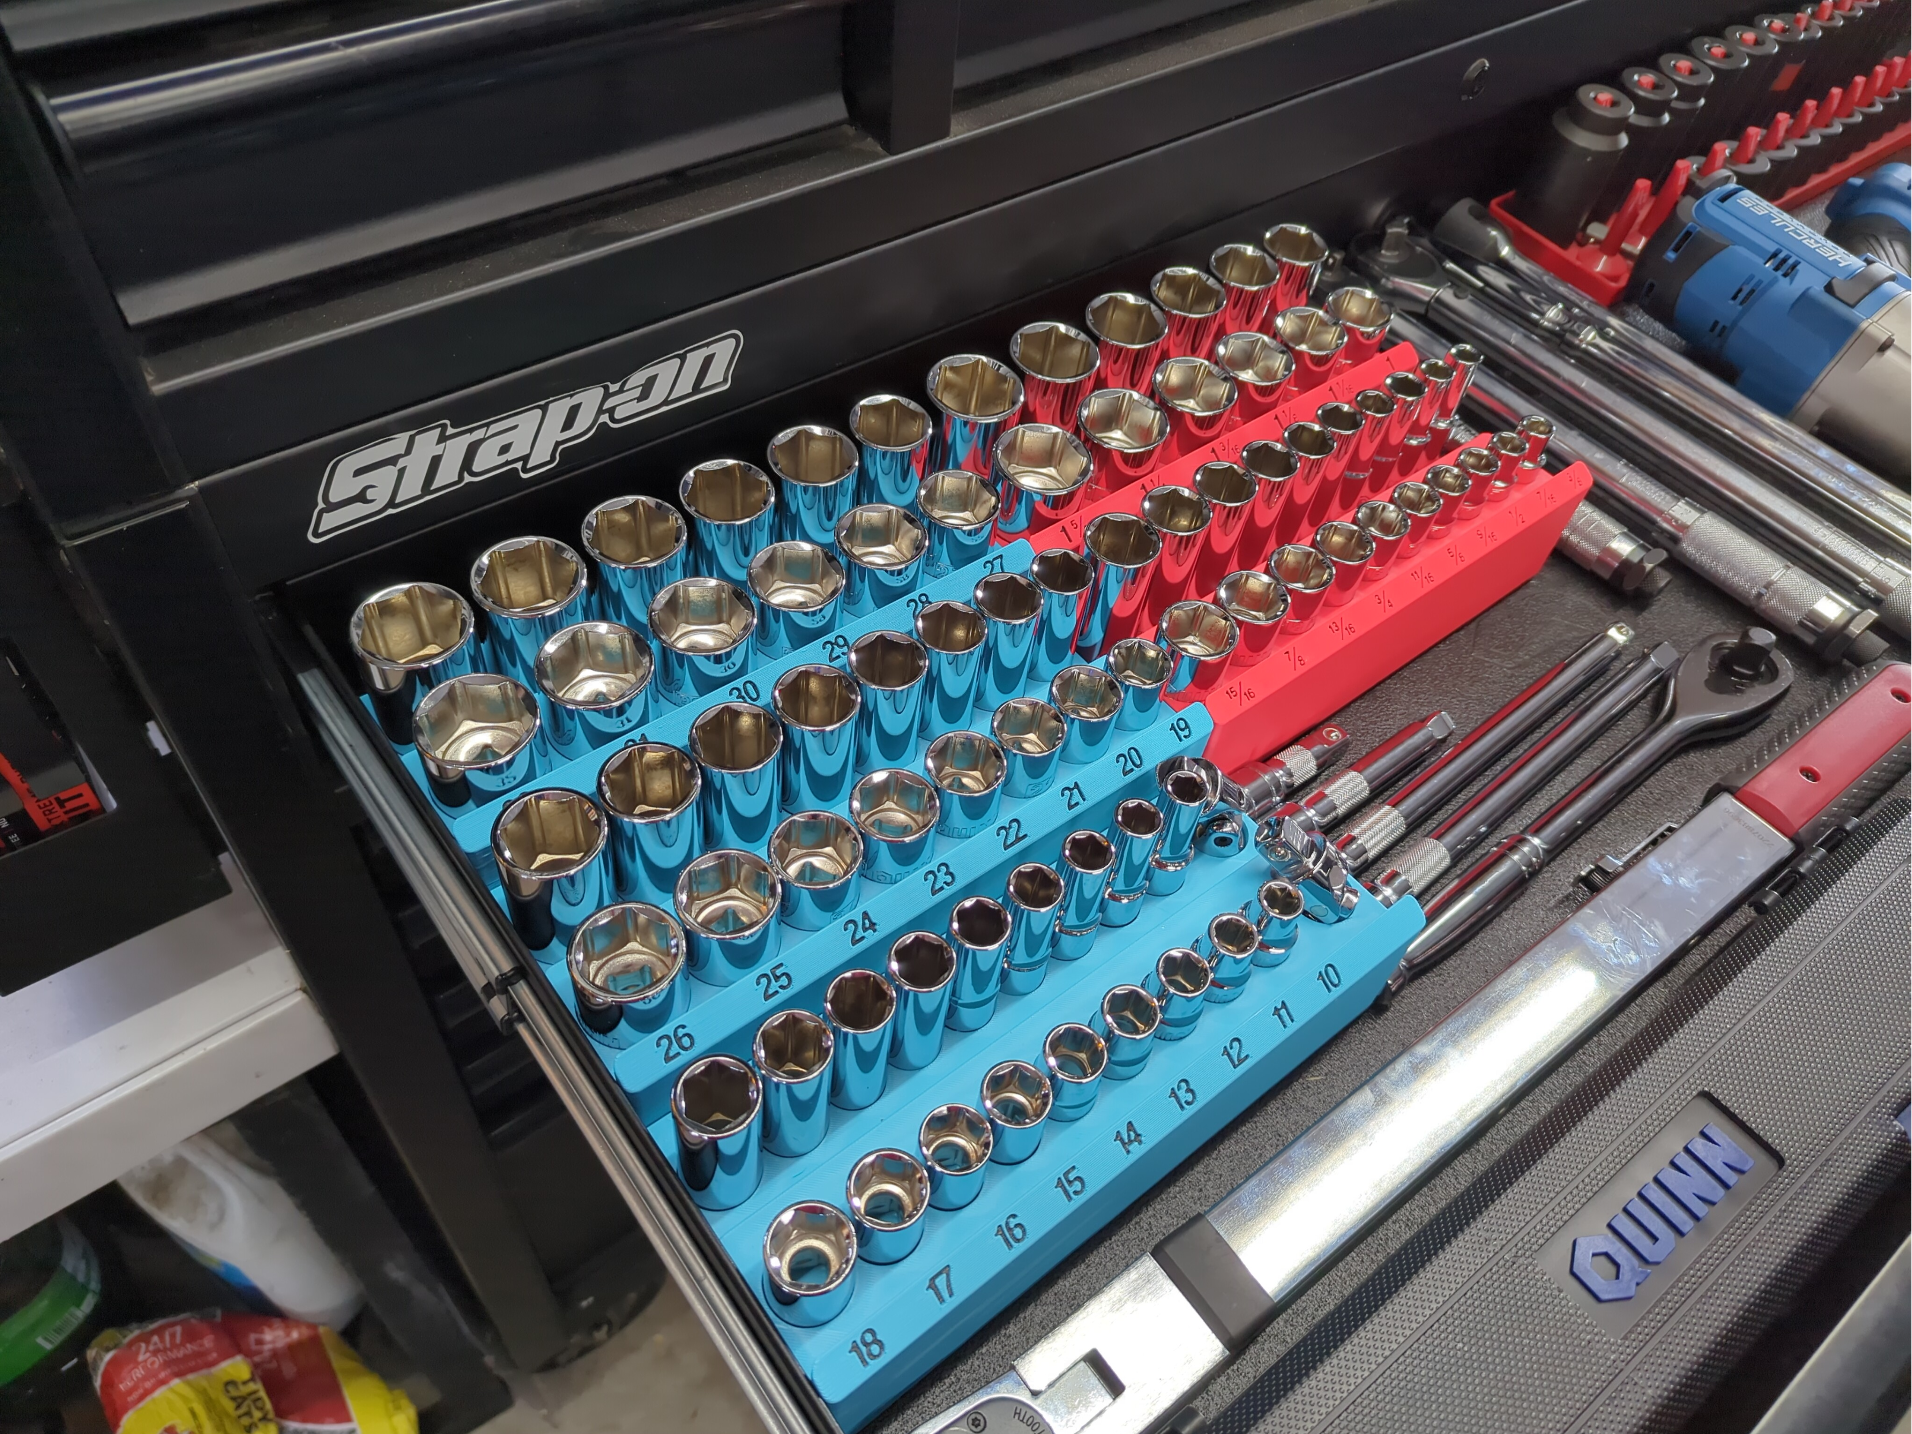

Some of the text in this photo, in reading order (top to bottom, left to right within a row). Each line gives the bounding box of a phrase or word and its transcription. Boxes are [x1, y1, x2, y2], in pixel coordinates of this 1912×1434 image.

[1737, 197, 1852, 267] HERCULES
[308, 330, 743, 543] Strap-on
[728, 680, 760, 702] 30
[1225, 681, 1256, 706] 15/16
[1284, 646, 1306, 671] 7/8
[1328, 617, 1356, 640] 13/16
[1374, 590, 1393, 613] 3/4
[1410, 566, 1434, 588] 11/16
[1508, 506, 1526, 527] 1/2
[655, 1024, 695, 1064] 26
[755, 962, 793, 1002] 25
[843, 910, 878, 947] 24
[923, 862, 956, 896] 23
[996, 818, 1028, 851] 22
[1060, 781, 1086, 811] 21
[1115, 746, 1143, 777] 20
[1169, 717, 1192, 742] 19
[848, 963, 1341, 1367] 18 17 16 15 14 13 12 11 10
[1569, 1122, 1755, 1302] QUINN
[132, 1325, 182, 1362] 24/7
